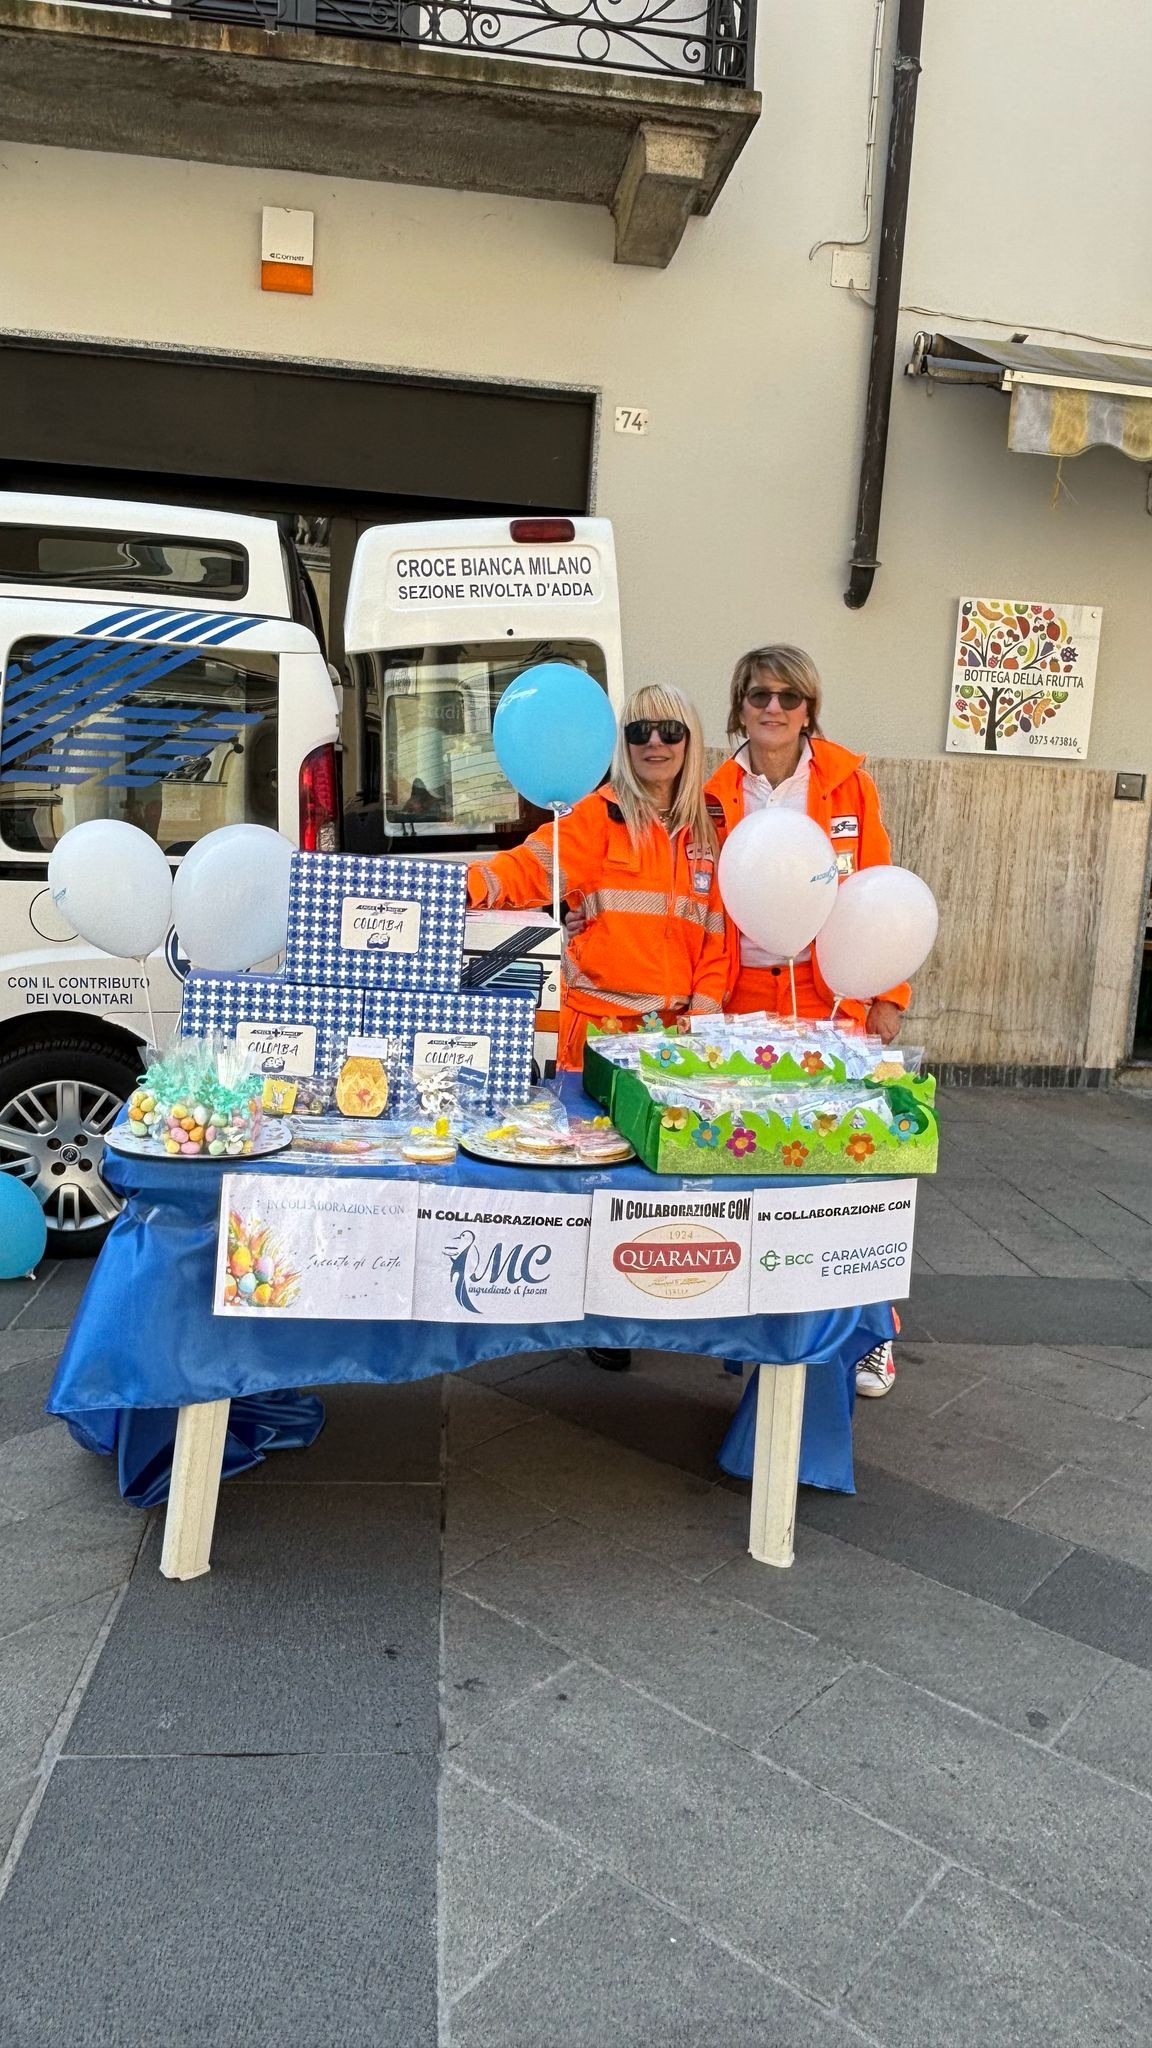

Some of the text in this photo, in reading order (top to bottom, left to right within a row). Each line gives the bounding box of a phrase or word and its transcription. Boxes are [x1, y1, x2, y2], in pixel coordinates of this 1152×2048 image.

[396, 556, 592, 578] CROCE BIANCA MILANO
[398, 582, 594, 600] SEZIONE RIVOLTA D'ADDA
[964, 669, 1084, 688] BOTTEGA DELLA FRUTTA
[1029, 734, 1078, 747] 0373 473816
[353, 917, 404, 933] COLOMBA
[7, 977, 150, 989] CON IL CONTRIBUTO
[26, 993, 133, 1005] DEI VOLONTARI
[247, 1041, 299, 1056] COLOMBA
[425, 1051, 474, 1066] COLOMBA
[267, 1199, 405, 1216] IN COLLABORAZIONE CON
[610, 1197, 751, 1221] IN COLLABORAZIONE CON
[757, 1200, 911, 1221] IN COLLABORAZIONE CON
[417, 1208, 592, 1227] IN COLLABORAZIONE CON
[470, 1242, 552, 1284] MC
[620, 1248, 737, 1271] QUARANTA
[785, 1241, 908, 1266] BCC CARAVAGGIO
[821, 1256, 906, 1277] E CREMASCO
